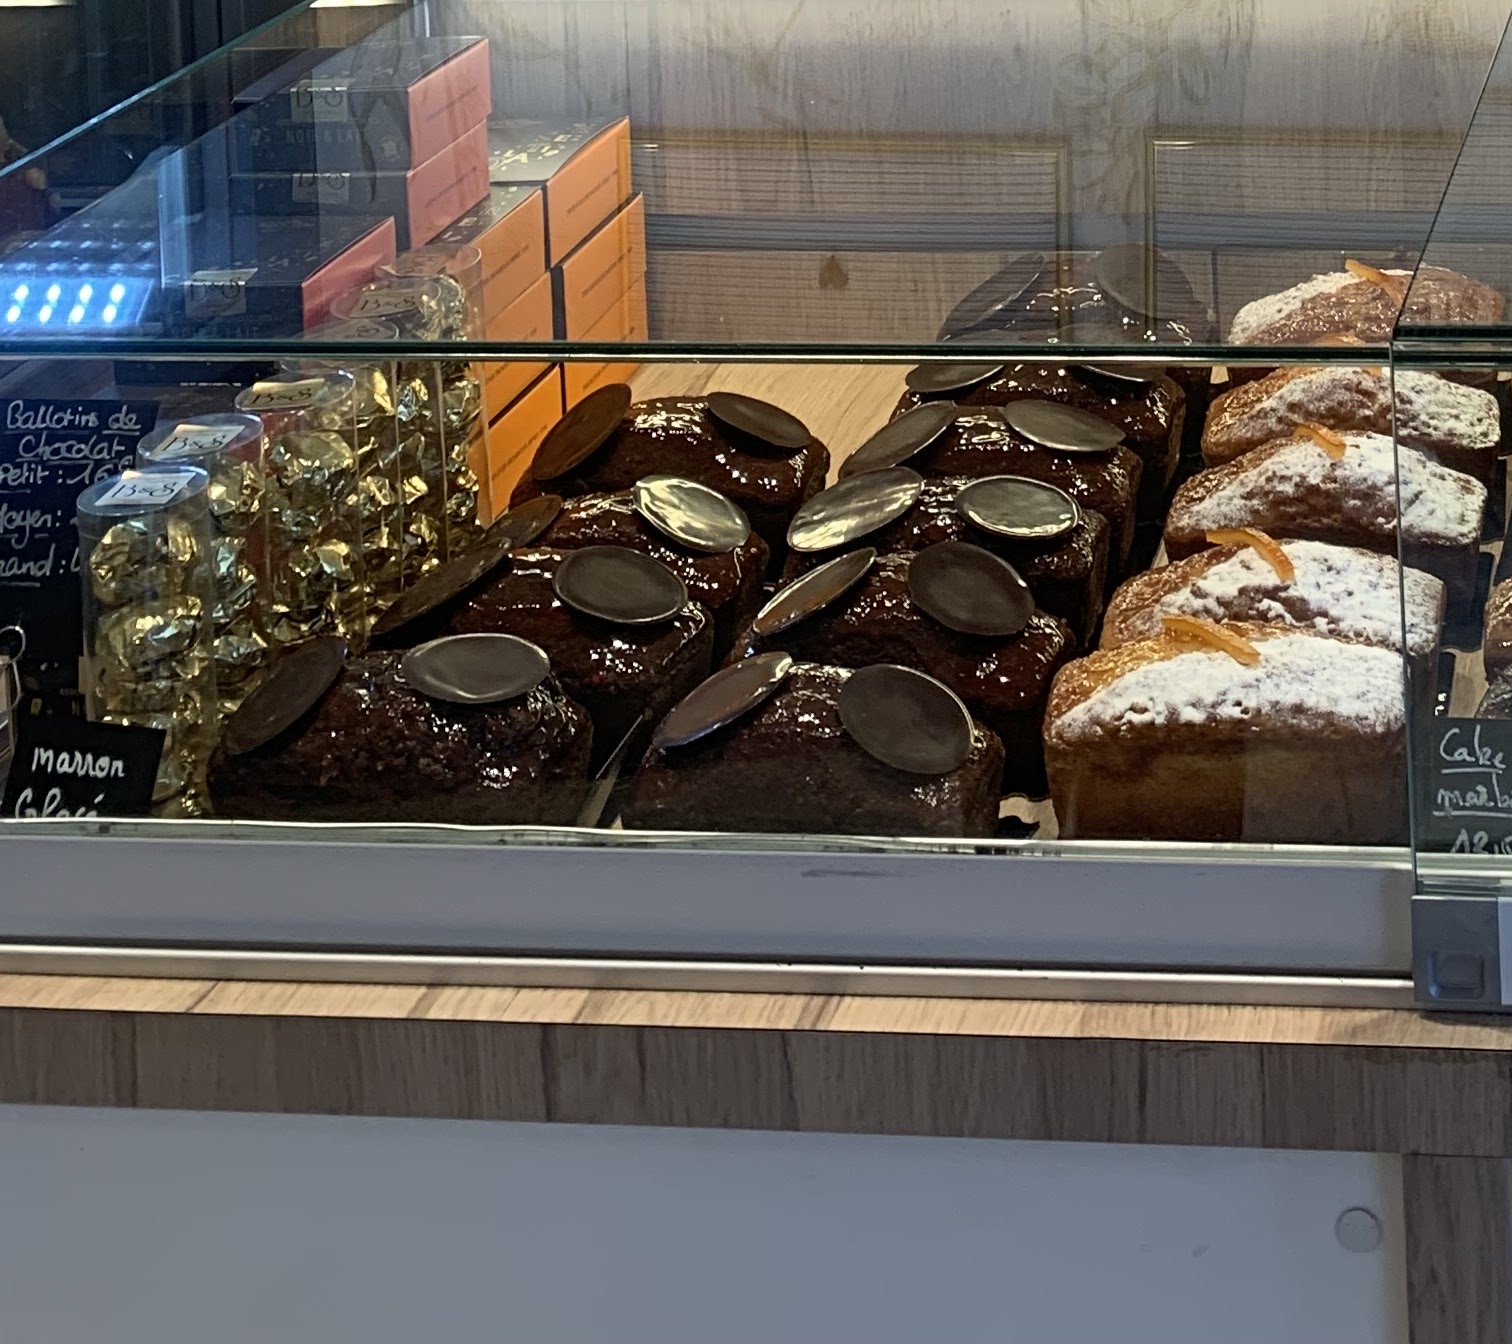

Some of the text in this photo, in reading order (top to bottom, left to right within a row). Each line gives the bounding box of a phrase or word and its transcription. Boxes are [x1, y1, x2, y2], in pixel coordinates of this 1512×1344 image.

[109, 405, 141, 430] de
[19, 432, 125, 460] Chocolat
[1440, 724, 1506, 769] Cake
[32, 747, 124, 777] marron
